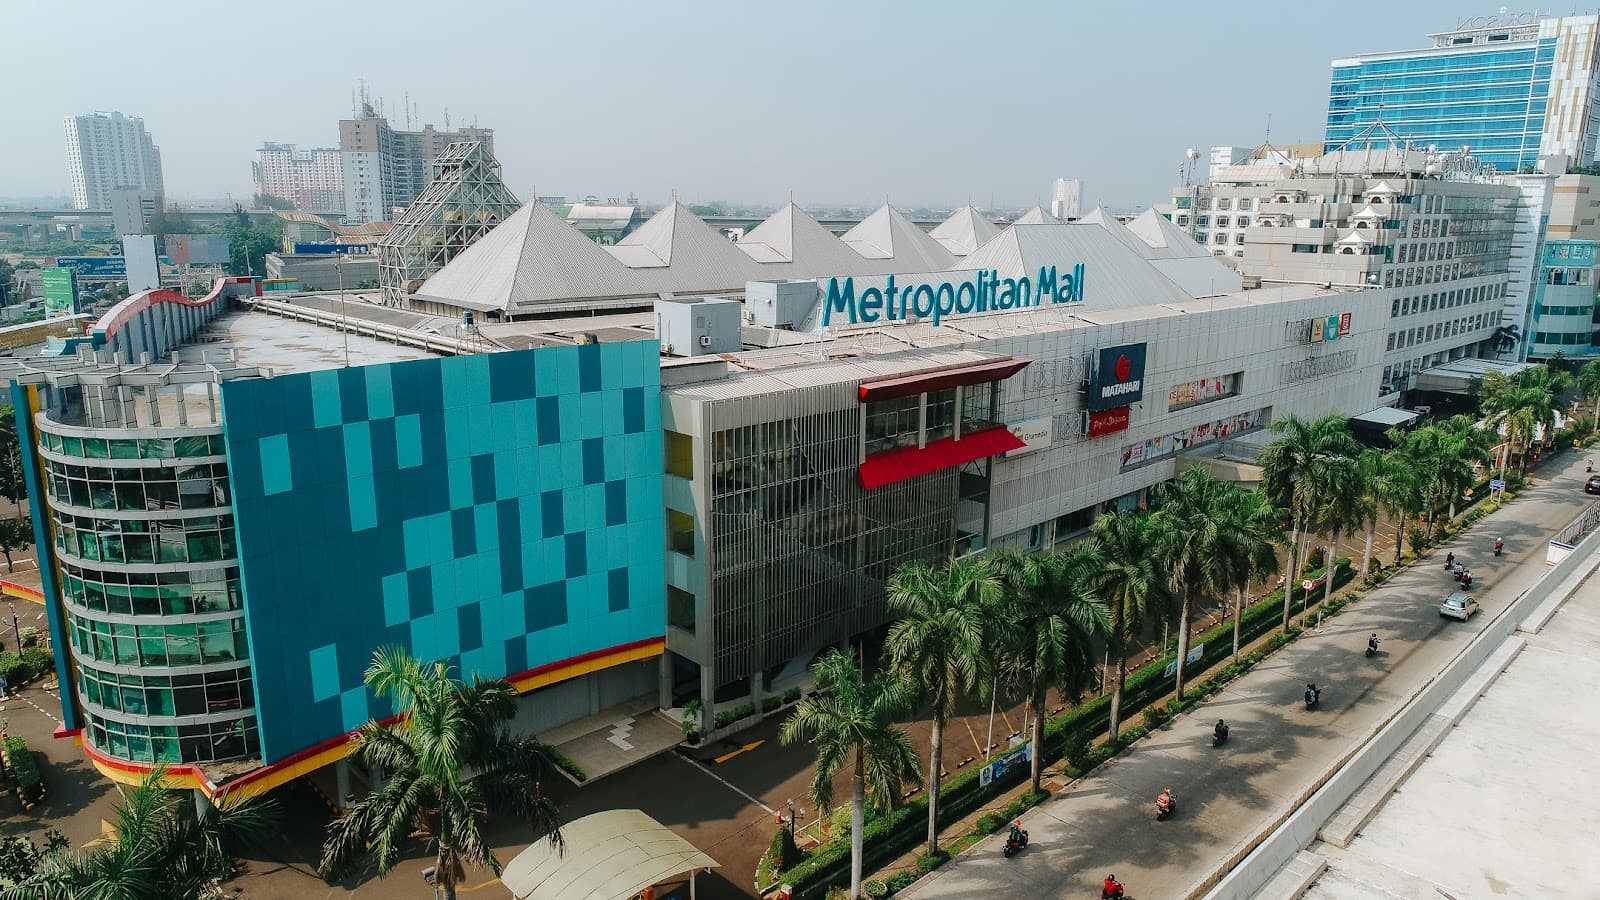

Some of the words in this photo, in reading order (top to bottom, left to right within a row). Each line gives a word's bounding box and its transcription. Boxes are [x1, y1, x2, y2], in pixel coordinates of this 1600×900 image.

[821, 268, 1031, 327] Metropolitan
[1033, 263, 1085, 306] Mall
[1101, 380, 1141, 398] MATAHARI
